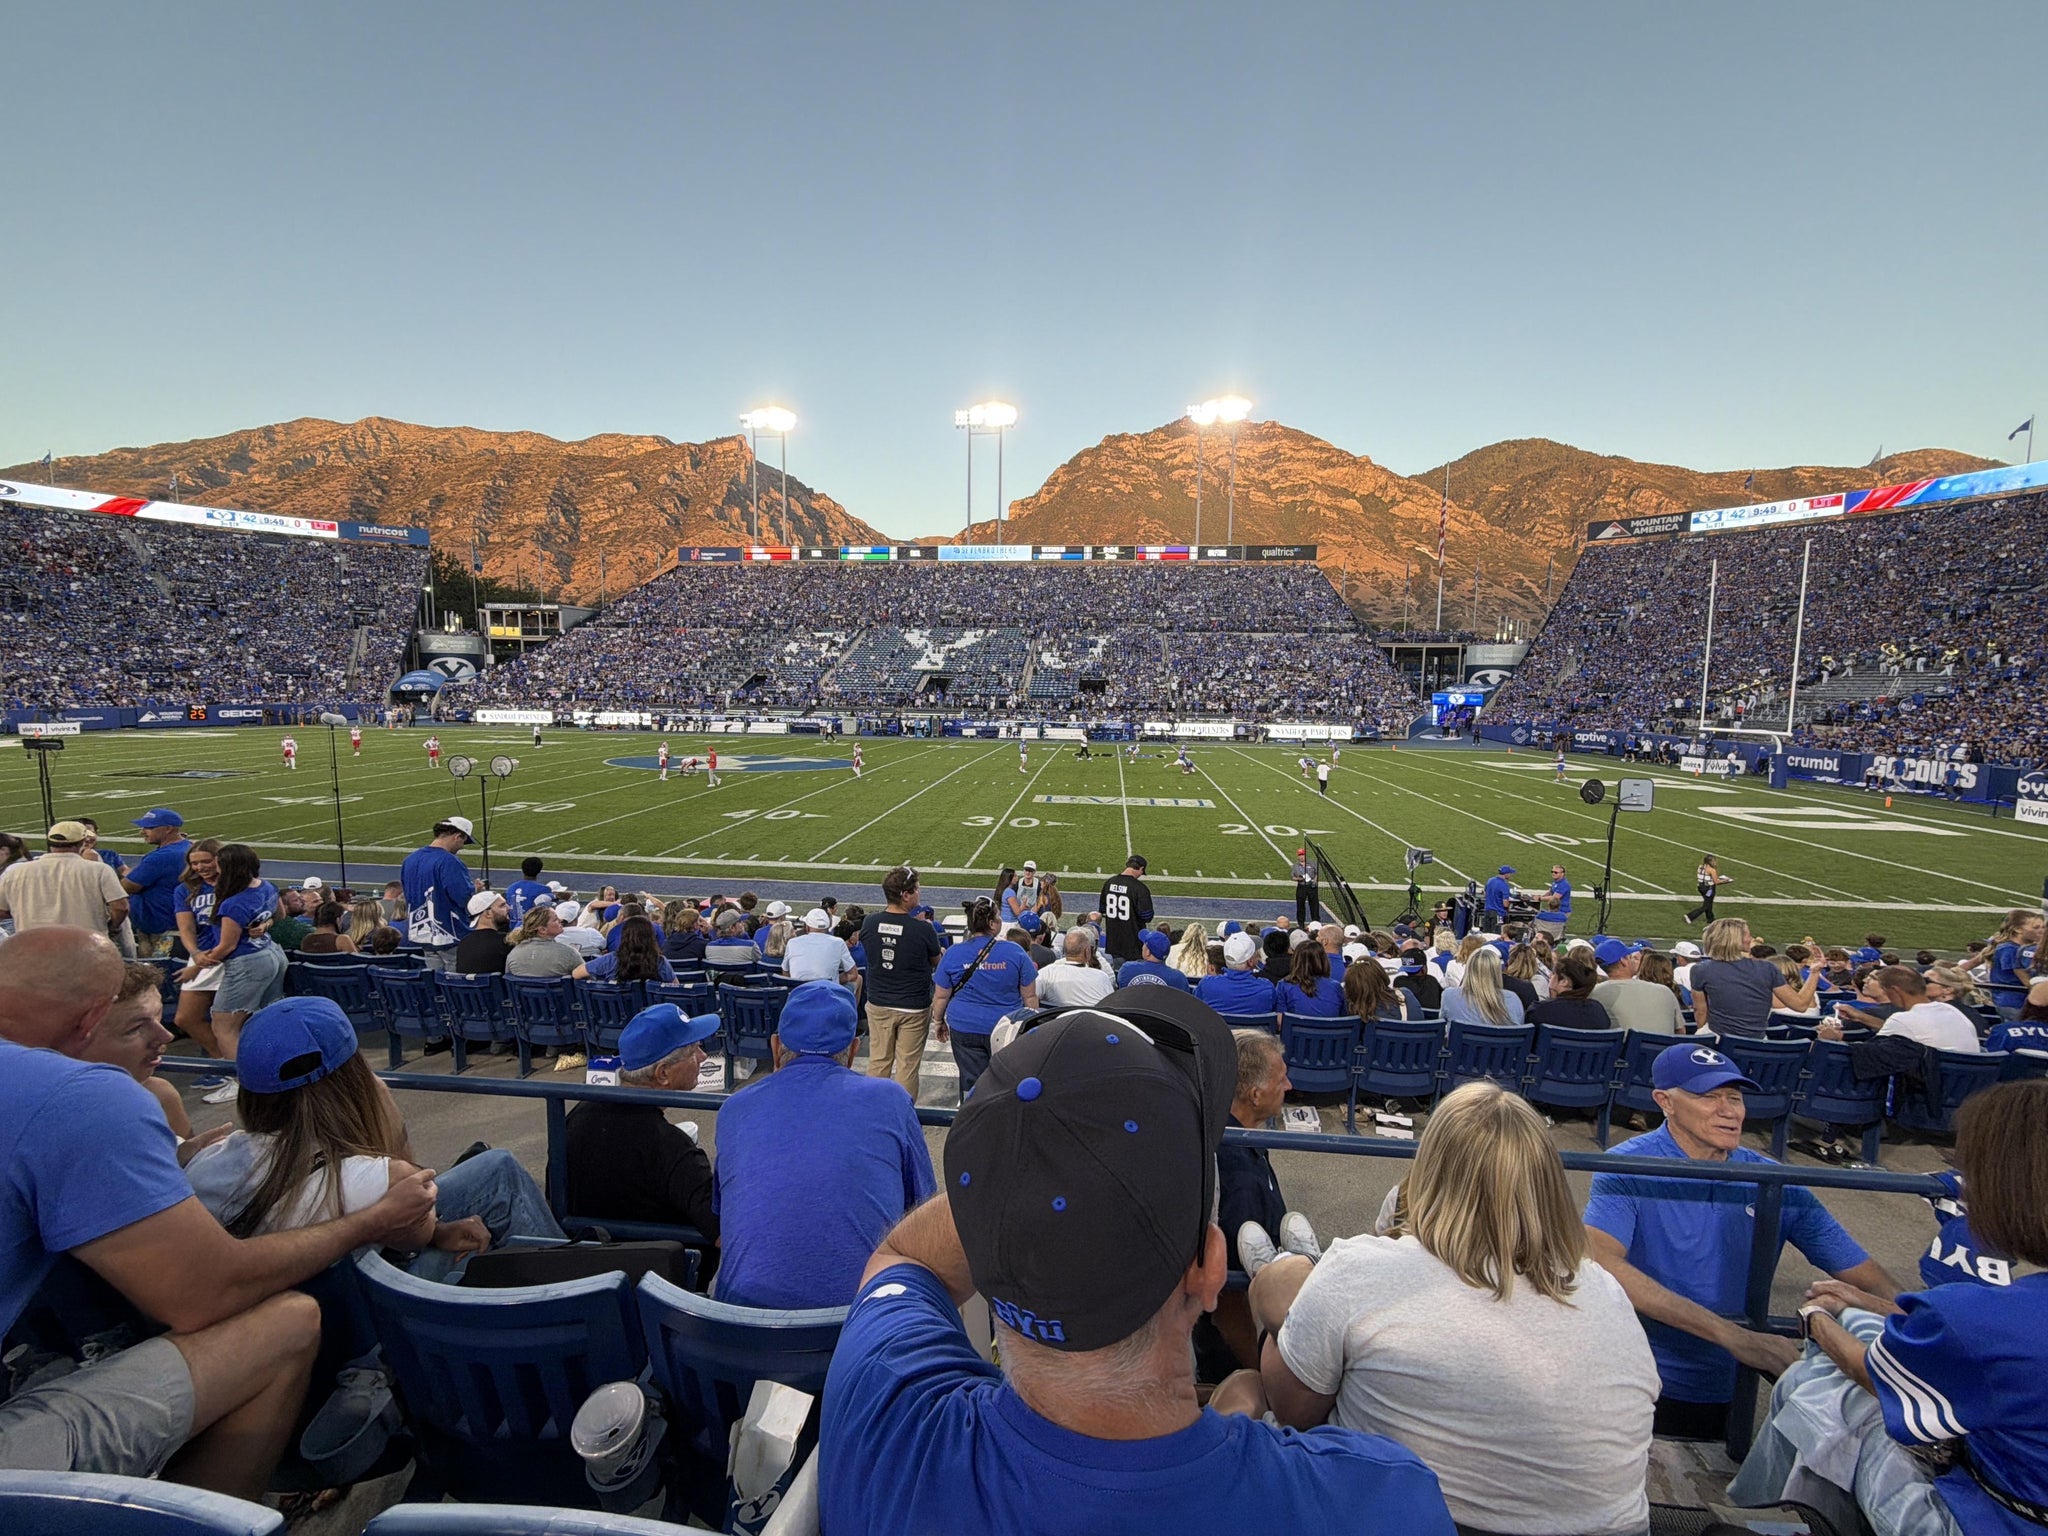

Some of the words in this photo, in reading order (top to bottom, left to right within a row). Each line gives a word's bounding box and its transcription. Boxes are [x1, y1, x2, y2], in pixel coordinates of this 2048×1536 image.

[1729, 508, 1746, 519] 42
[1753, 505, 1777, 516] 9:49
[1788, 502, 1796, 512] 0
[243, 514, 257, 524] 42
[264, 517, 284, 527] 9:49
[294, 519, 301, 529] 0
[1630, 515, 1683, 528] MOUNTAIN
[359, 525, 409, 537] nutricost
[1633, 523, 1680, 535] AMERICA
[1262, 547, 1295, 559] qualtrics
[190, 709, 206, 720] 25
[218, 709, 263, 718] GEICO
[1574, 731, 1608, 743] aptive
[1787, 755, 1840, 772] crumbl
[721, 808, 801, 820] 40
[962, 815, 1041, 828] 30
[1217, 823, 1300, 838] 20
[1498, 830, 1582, 847] 10
[1105, 893, 1131, 921] 89
[963, 961, 1007, 971] wkfront
[991, 1296, 1067, 1342] BYU
